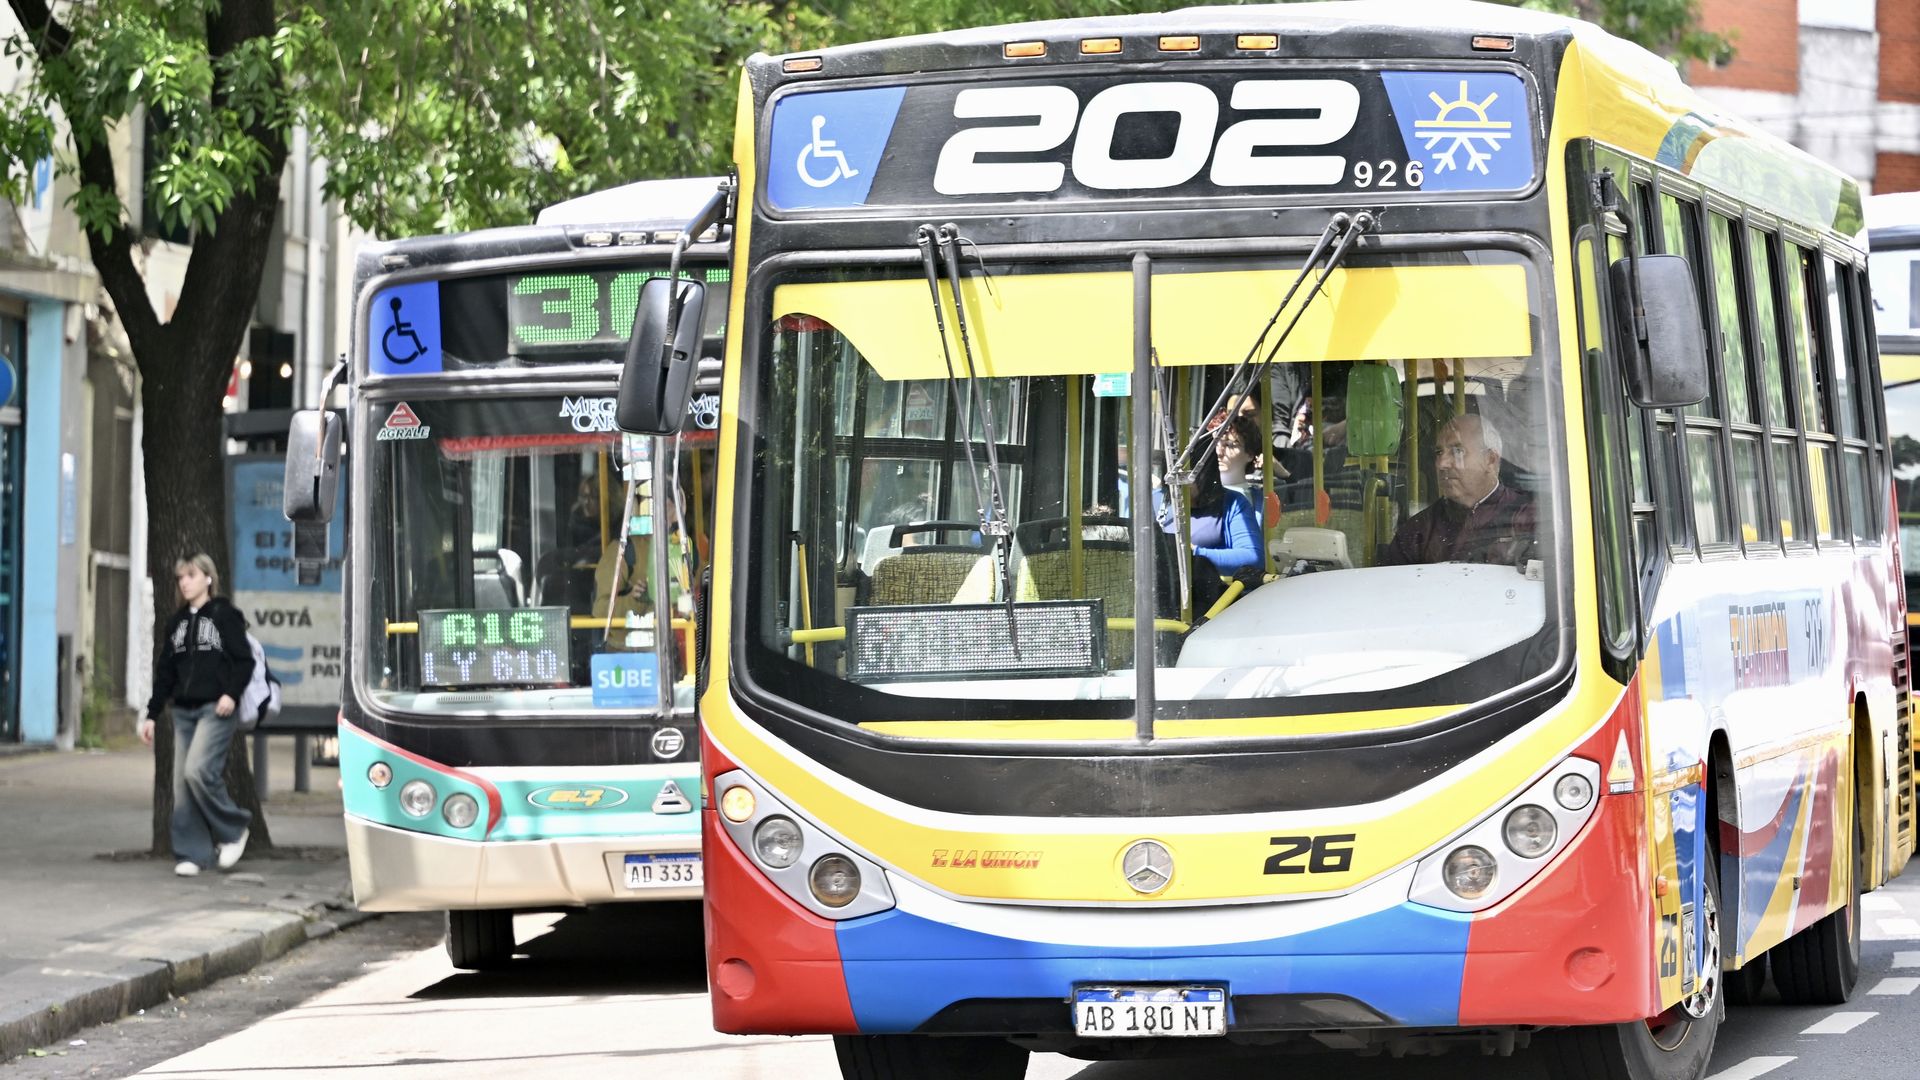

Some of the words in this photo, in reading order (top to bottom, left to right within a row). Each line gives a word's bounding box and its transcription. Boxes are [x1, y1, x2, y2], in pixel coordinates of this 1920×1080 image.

[934, 79, 1360, 195] 202
[1354, 160, 1424, 188] 926
[376, 426, 431, 441] AGRALE
[254, 606, 313, 628] VOTÁ
[443, 611, 544, 645] A16
[493, 649, 557, 681] 610
[598, 668, 652, 689] SUBE
[950, 849, 978, 868] LA
[980, 850, 1044, 869] UNION
[1263, 832, 1356, 875] 26
[631, 865, 652, 883] AD
[659, 863, 693, 881] 333
[1085, 1006, 1115, 1031] AB
[1126, 1006, 1174, 1031] 180
[1184, 1006, 1216, 1031] NT
